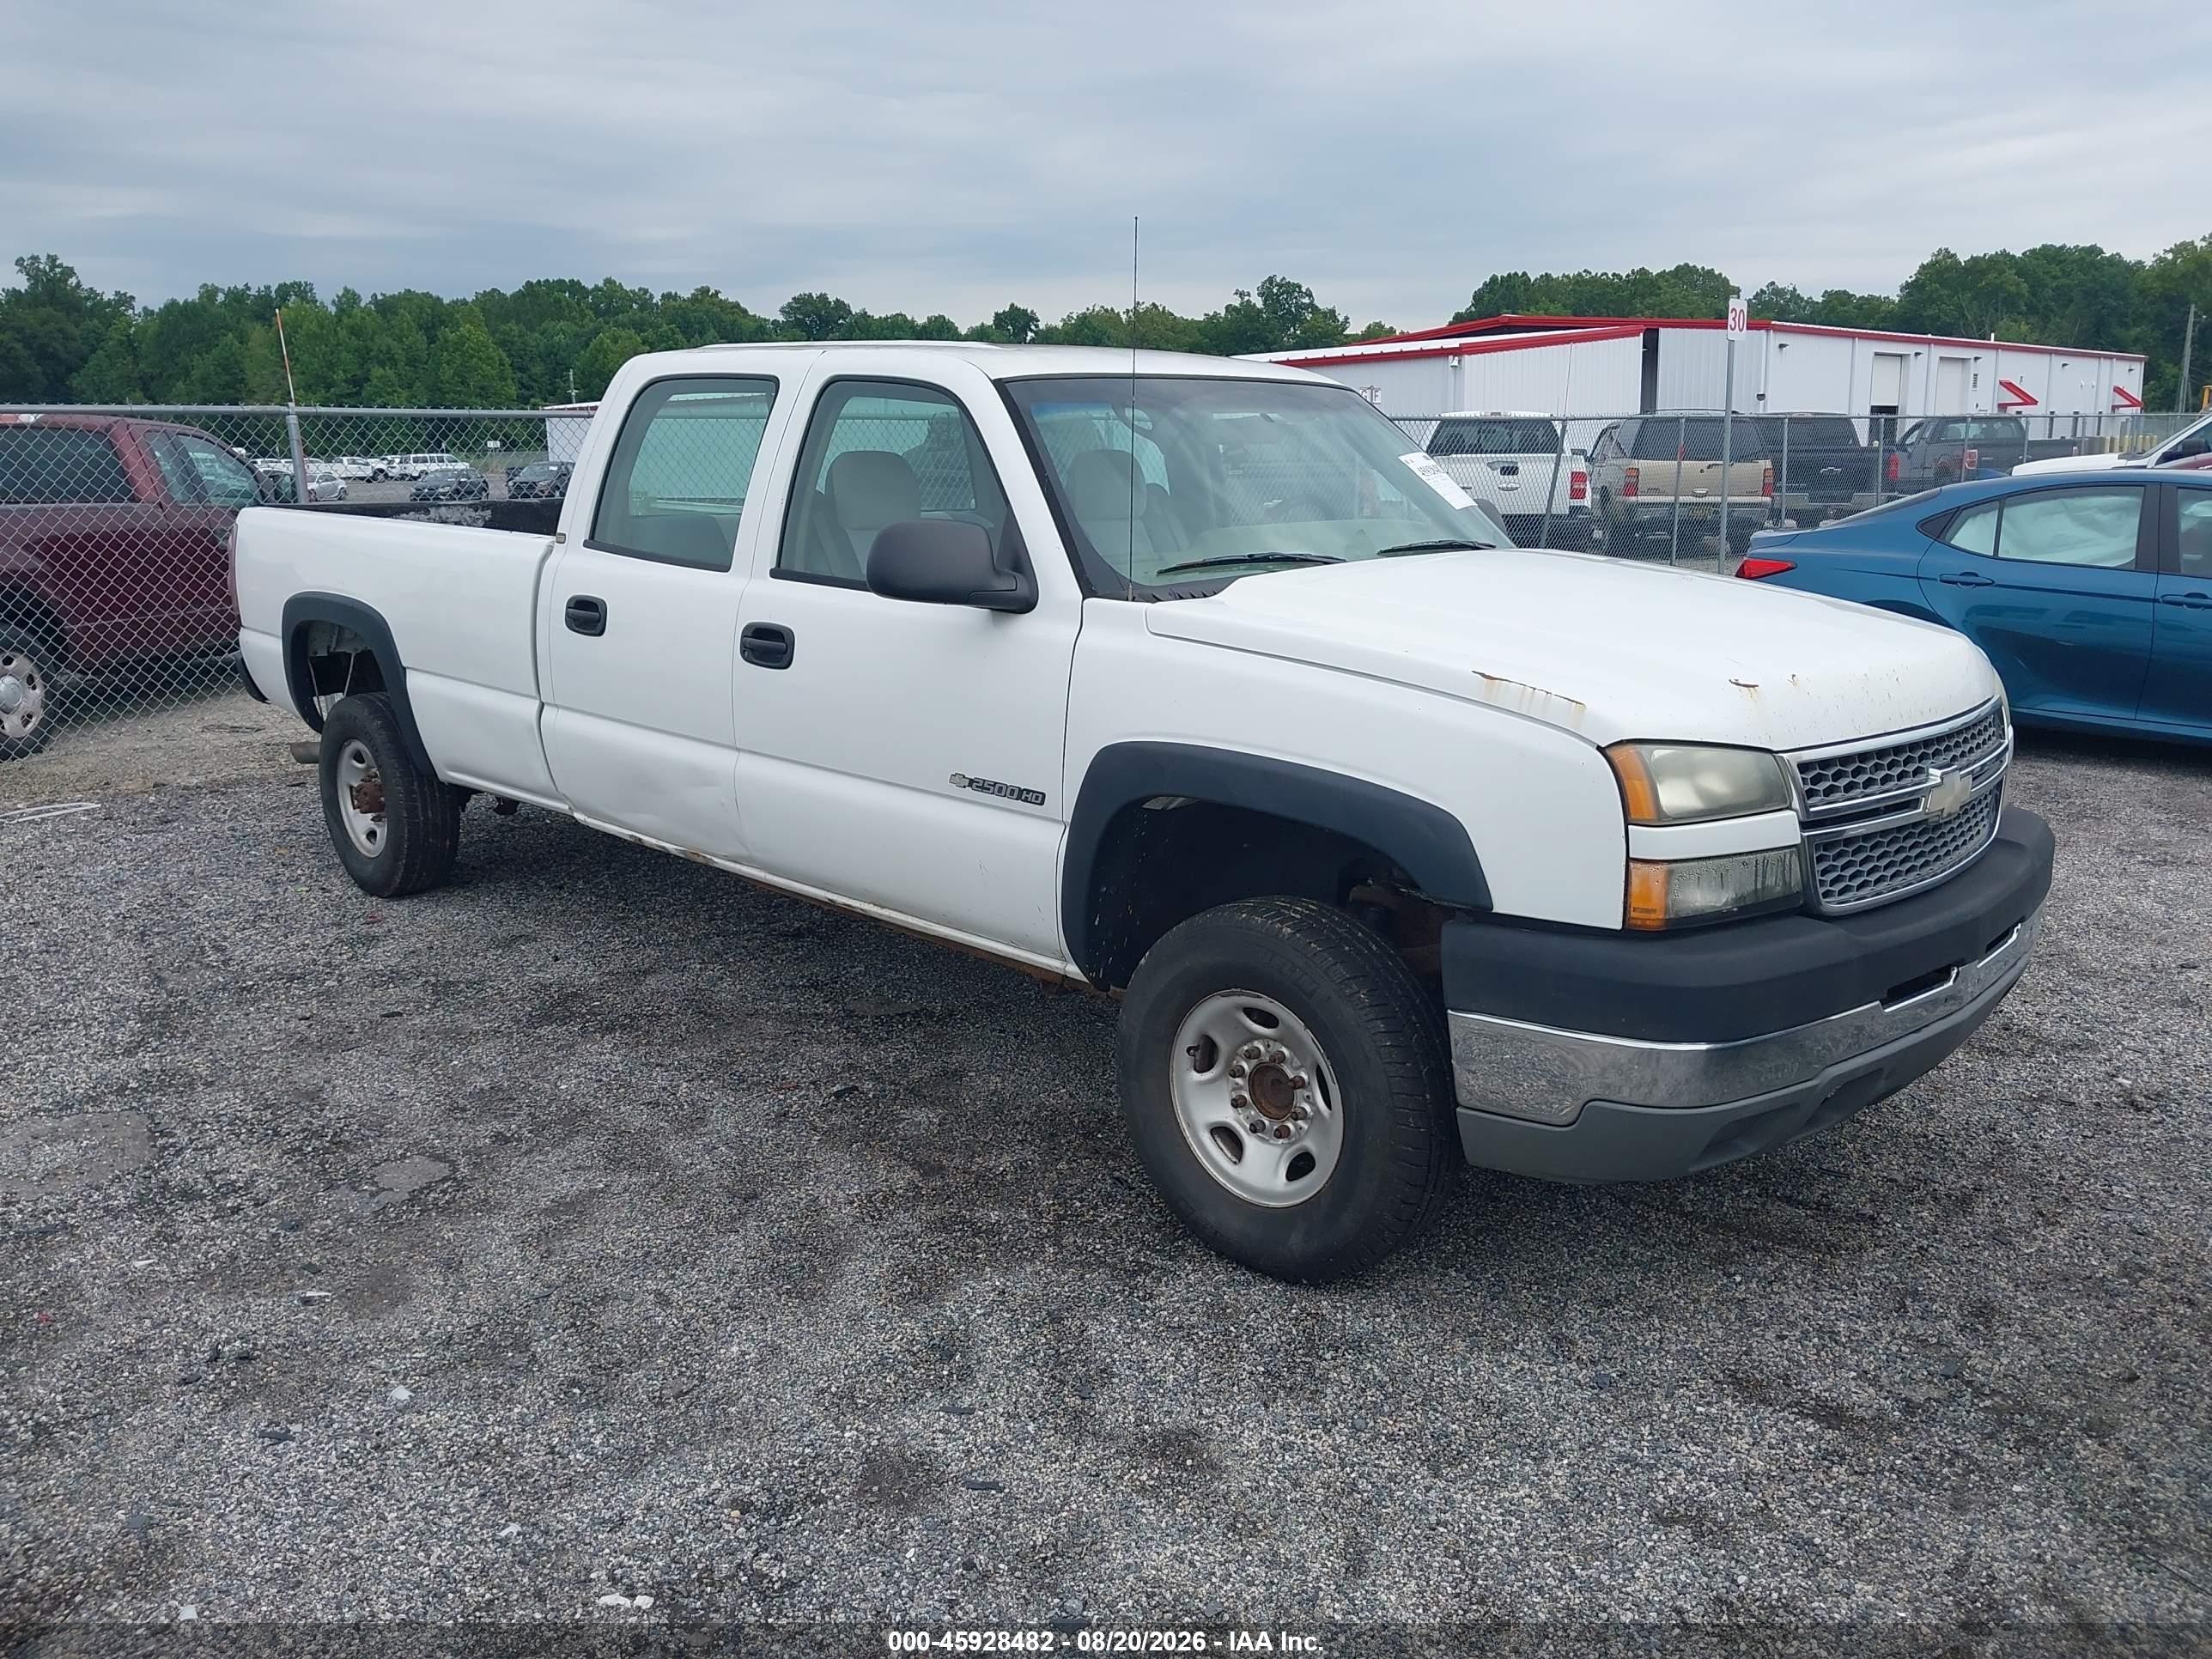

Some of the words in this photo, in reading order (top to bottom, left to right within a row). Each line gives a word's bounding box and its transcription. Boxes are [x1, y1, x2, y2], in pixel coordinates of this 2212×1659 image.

[1729, 307, 1746, 332] 30
[1374, 390, 1379, 402] F
[971, 777, 1019, 800] 2500
